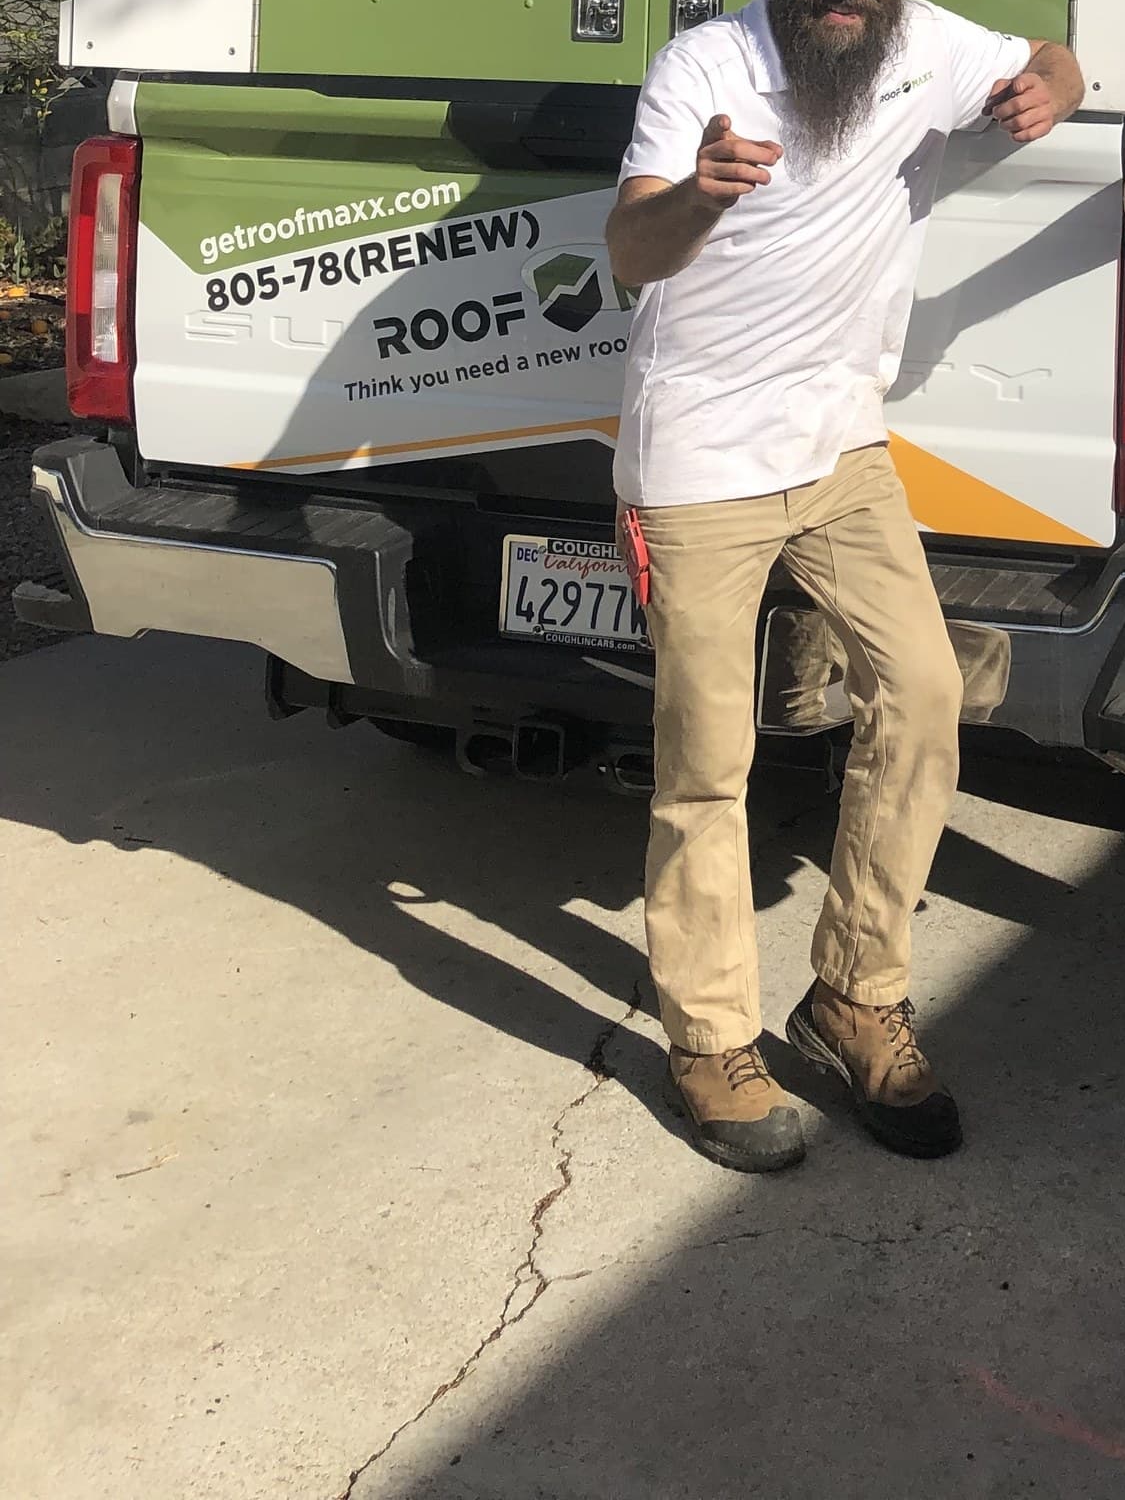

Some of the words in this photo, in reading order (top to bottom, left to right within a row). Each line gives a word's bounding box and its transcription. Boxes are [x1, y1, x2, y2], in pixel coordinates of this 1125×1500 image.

[879, 87, 901, 104] ROOF
[200, 180, 462, 265] getroofmaxx.com
[205, 209, 541, 313] 805-78(RENEW)
[373, 291, 526, 360] ROOF
[344, 375, 405, 402] Think
[410, 368, 450, 395] you
[456, 355, 510, 382] need
[517, 353, 531, 372] a
[536, 345, 581, 368] new
[589, 336, 631, 360] roo
[516, 546, 539, 563] DEC
[552, 540, 622, 559] COUGHL
[543, 553, 628, 580] Californ
[545, 632, 636, 652] COUGHLINCARS.com
